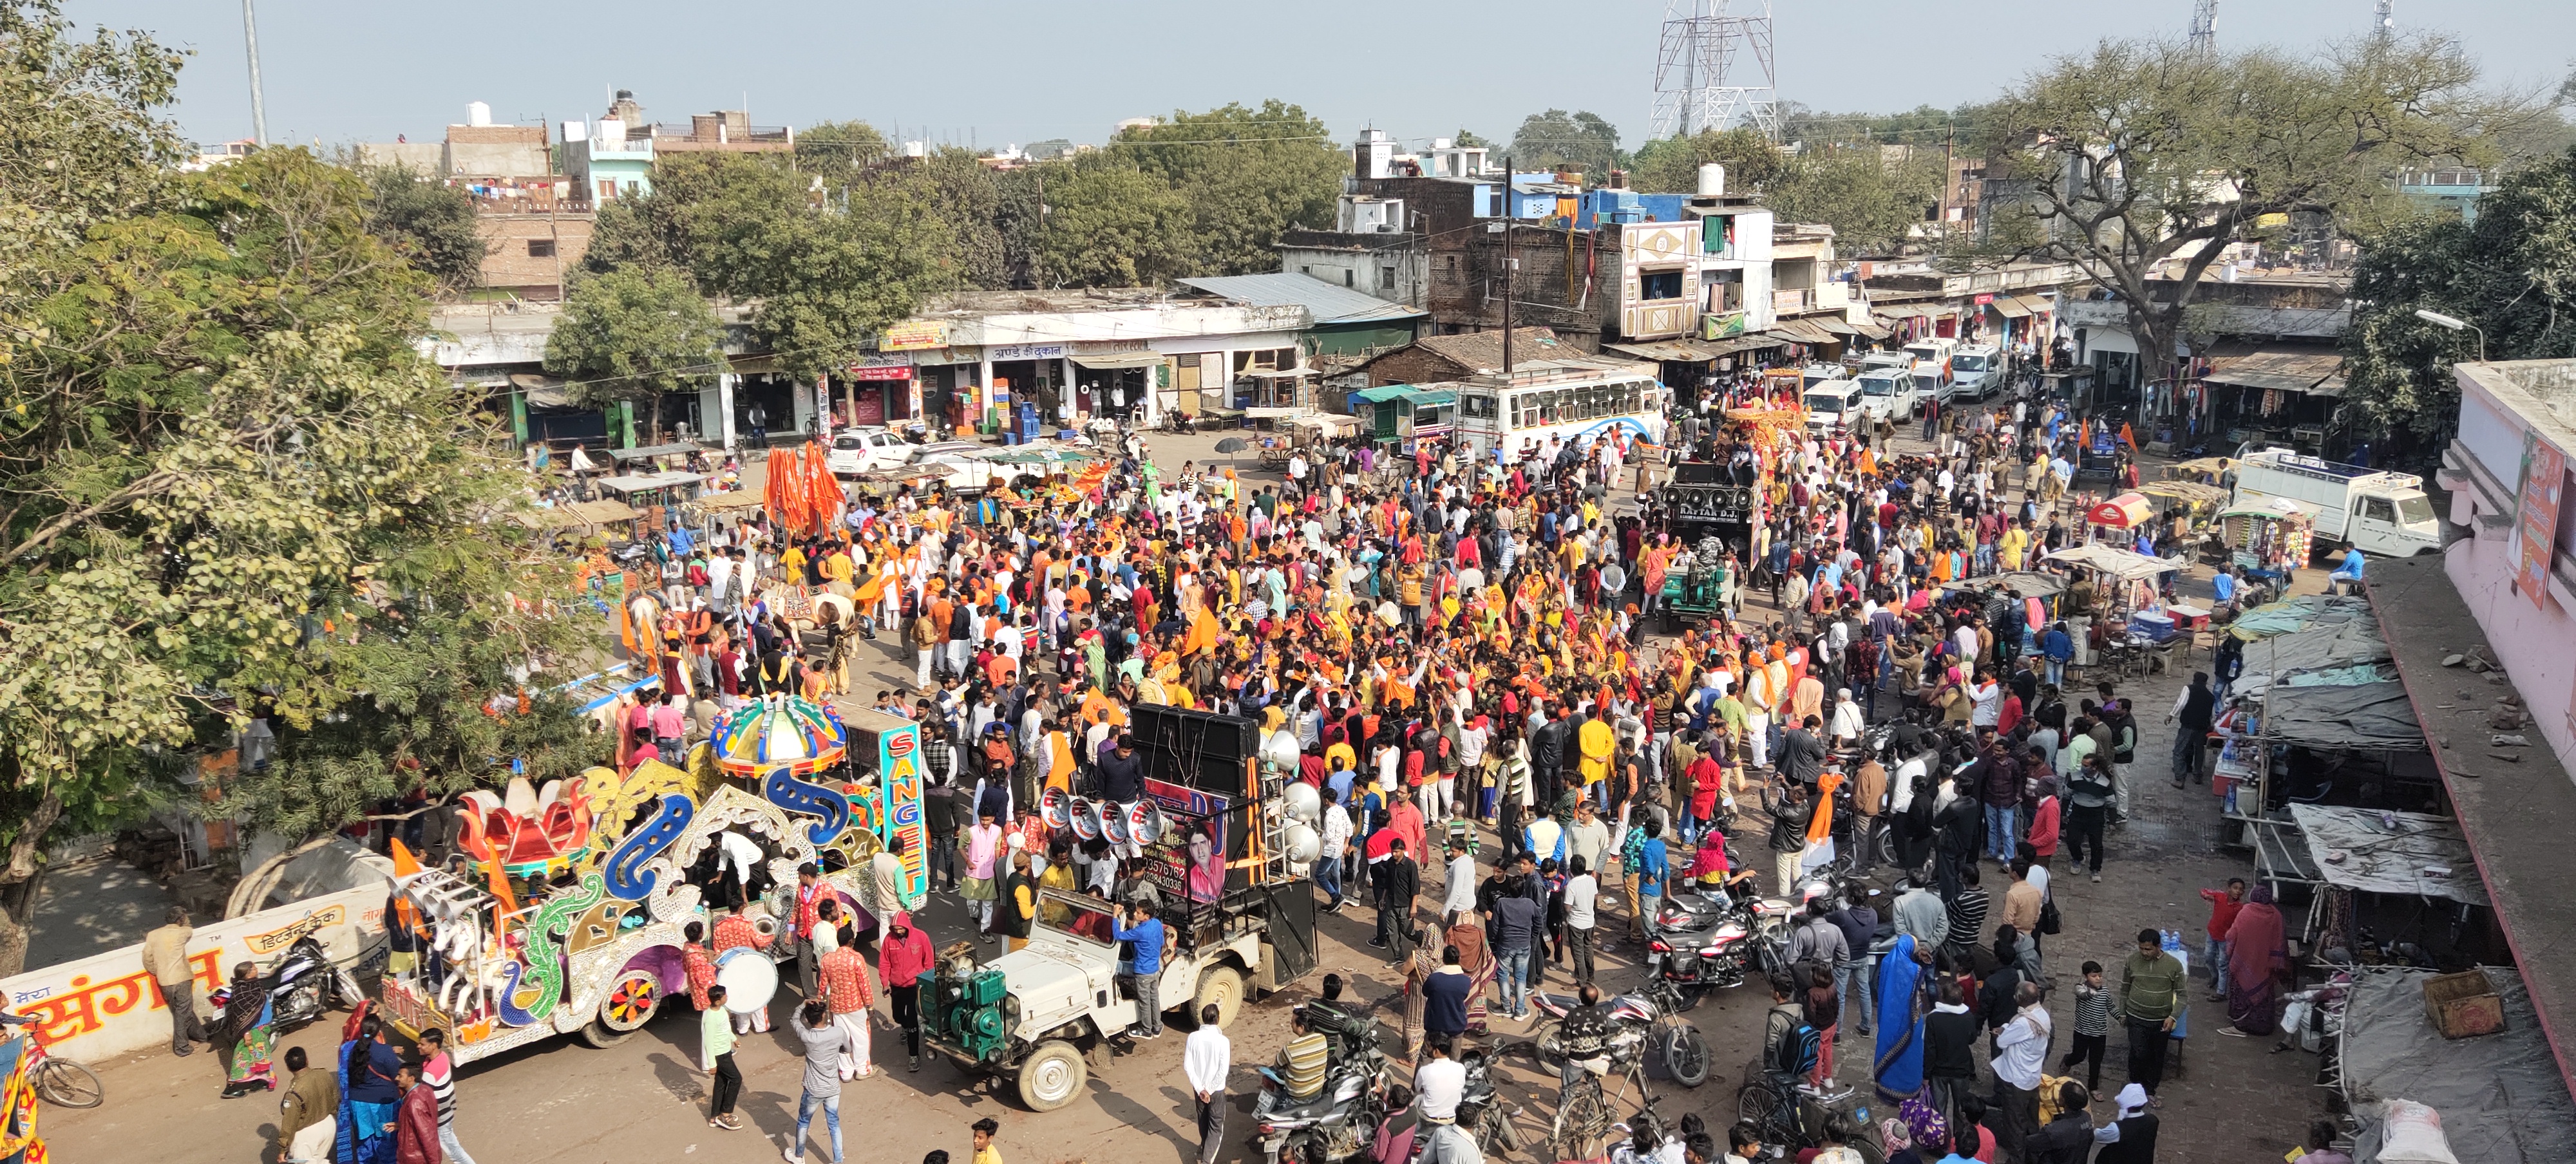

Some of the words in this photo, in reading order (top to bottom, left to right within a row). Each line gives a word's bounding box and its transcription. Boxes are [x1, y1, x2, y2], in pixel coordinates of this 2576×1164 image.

[992, 345, 1020, 359] अण्डे
[1023, 346, 1033, 356] की
[1034, 346, 1061, 359] दुकान
[1720, 510, 1738, 518] D.J.
[887, 734, 923, 894] SANGEET
[15, 987, 51, 1004] मेरा
